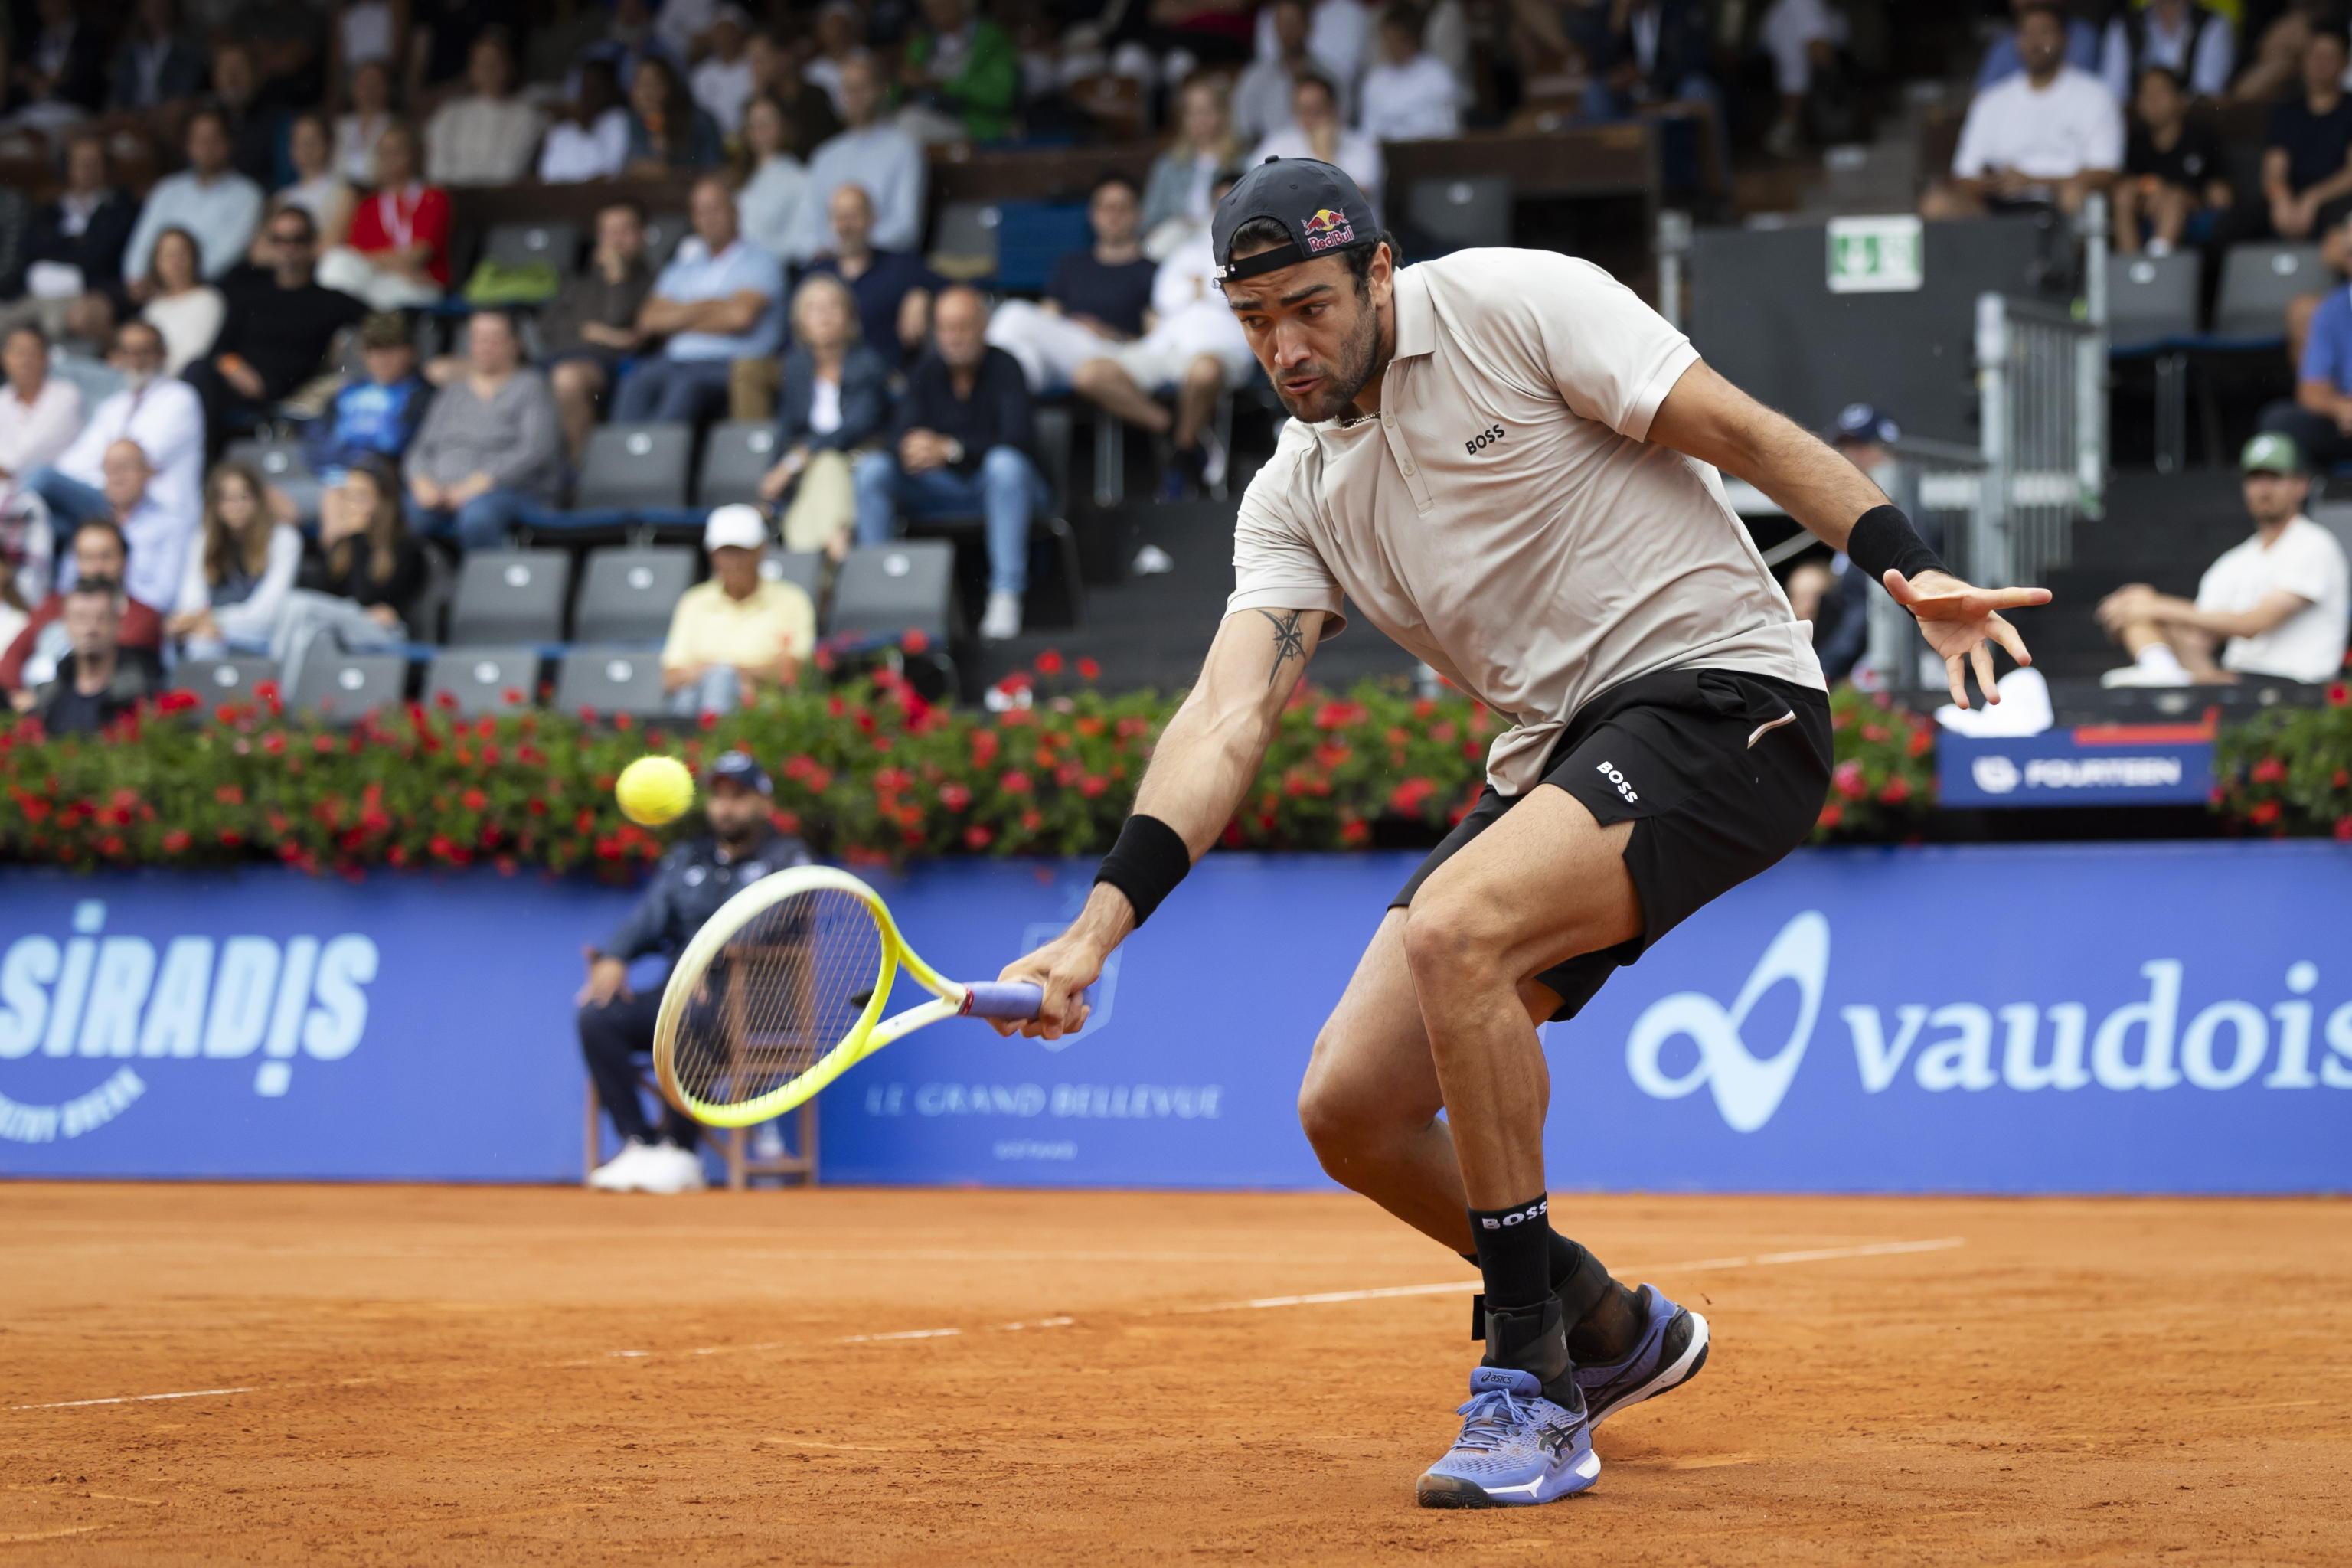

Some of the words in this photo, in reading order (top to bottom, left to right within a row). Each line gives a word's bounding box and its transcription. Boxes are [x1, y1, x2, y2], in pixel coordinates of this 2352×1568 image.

[1465, 423, 1505, 456] BOSS
[1596, 760, 1638, 803] BOSS
[2024, 757, 2182, 789] FOURTEEN
[864, 1083, 905, 1116] LE
[915, 1082, 1046, 1118] GRAND
[1050, 1083, 1223, 1119] BELLEVUE
[1482, 1200, 1547, 1229] BOSS
[1491, 1374, 1513, 1384] asics
